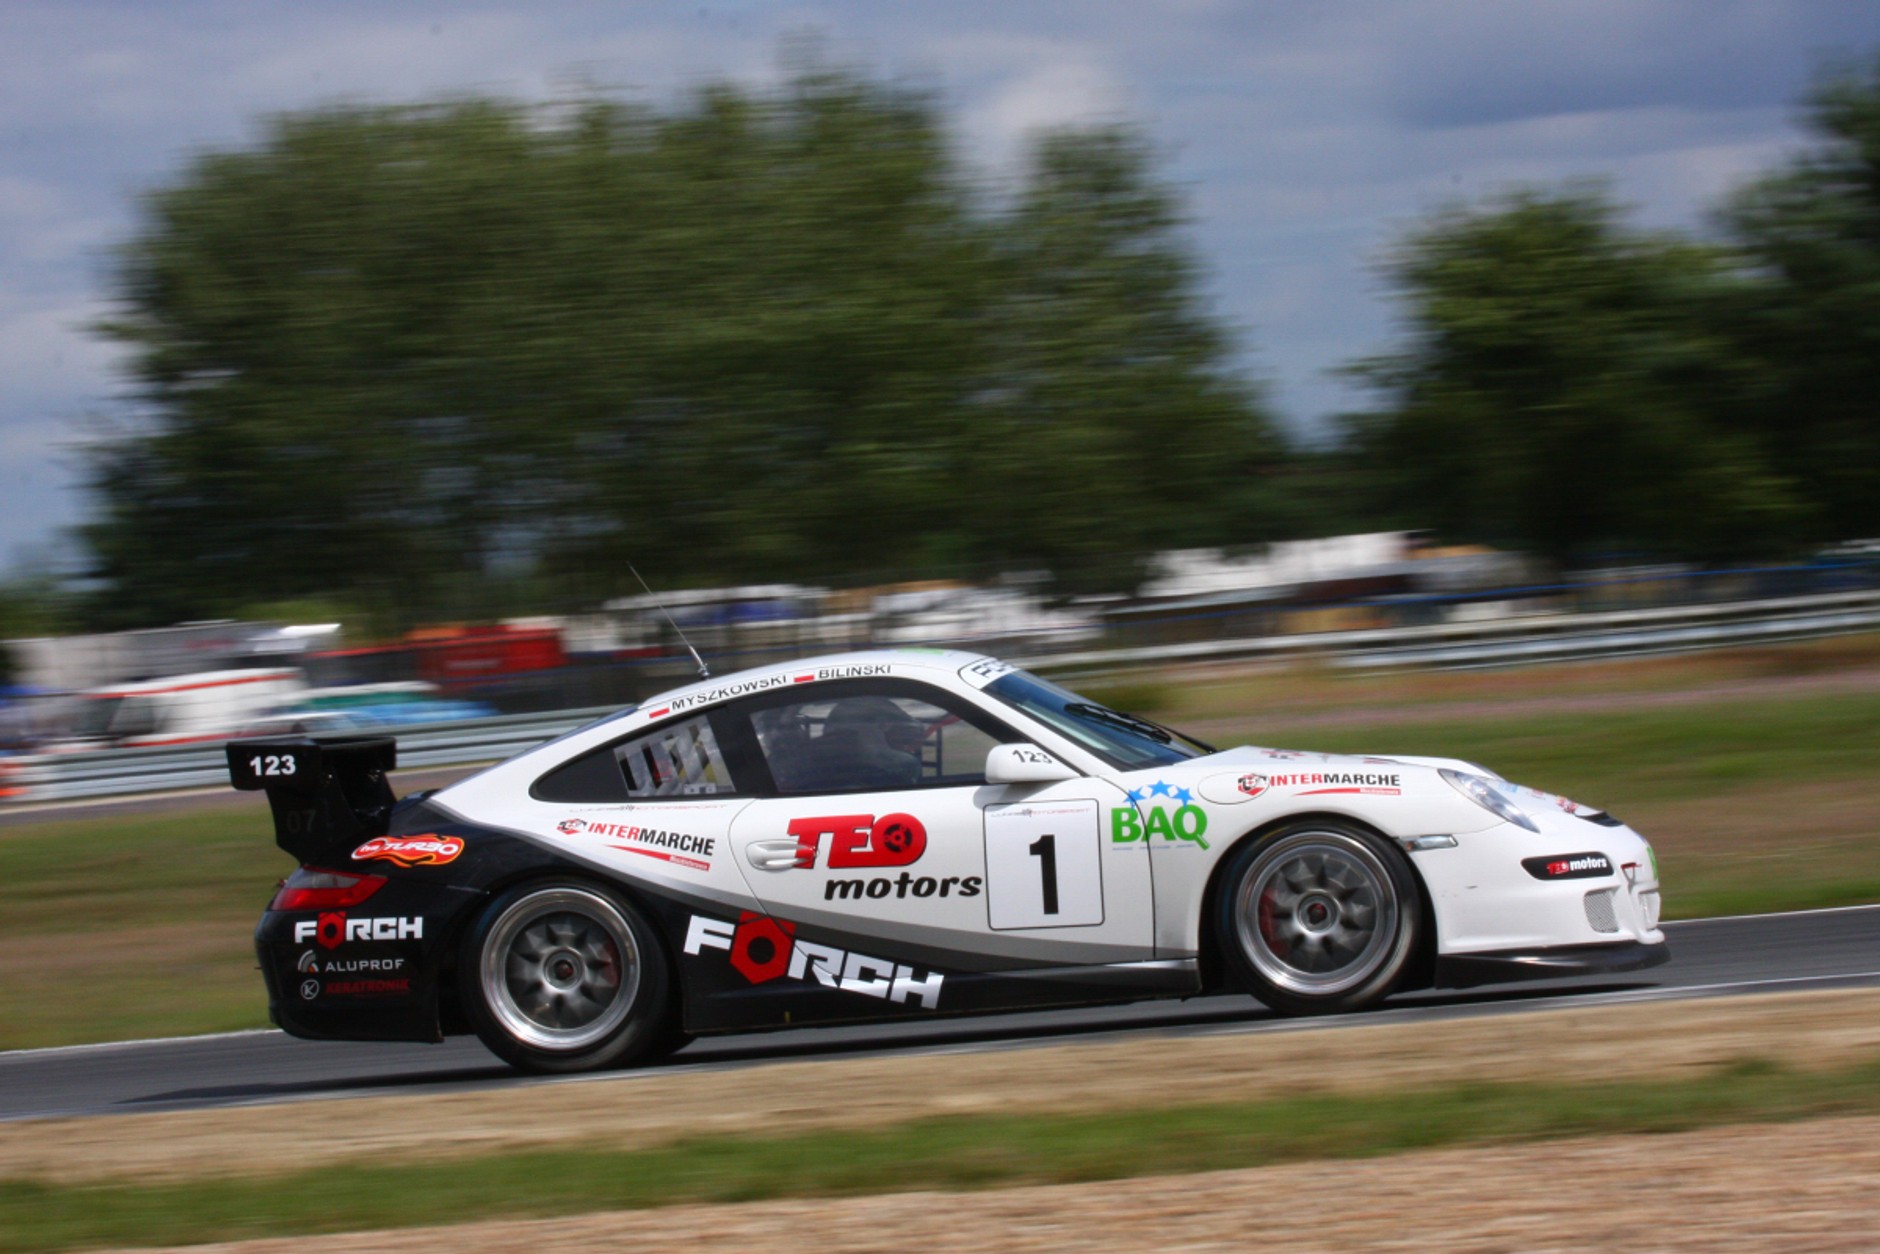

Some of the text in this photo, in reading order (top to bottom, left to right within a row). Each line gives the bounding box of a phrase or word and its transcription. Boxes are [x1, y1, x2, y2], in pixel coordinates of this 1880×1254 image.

[671, 674, 787, 711] MYSZKOWSKI
[250, 755, 296, 776] 123
[1012, 749, 1053, 764] 123
[1270, 773, 1401, 787] INTERMARCHE
[587, 822, 716, 857] INTERMARCHE
[1110, 804, 1211, 851] BAQ
[384, 841, 459, 856] TURBO
[787, 812, 927, 869] TEO
[1029, 834, 1060, 915] 1
[1570, 857, 1607, 872] motors
[823, 872, 983, 900] motors
[325, 958, 405, 972] ALUPROF
